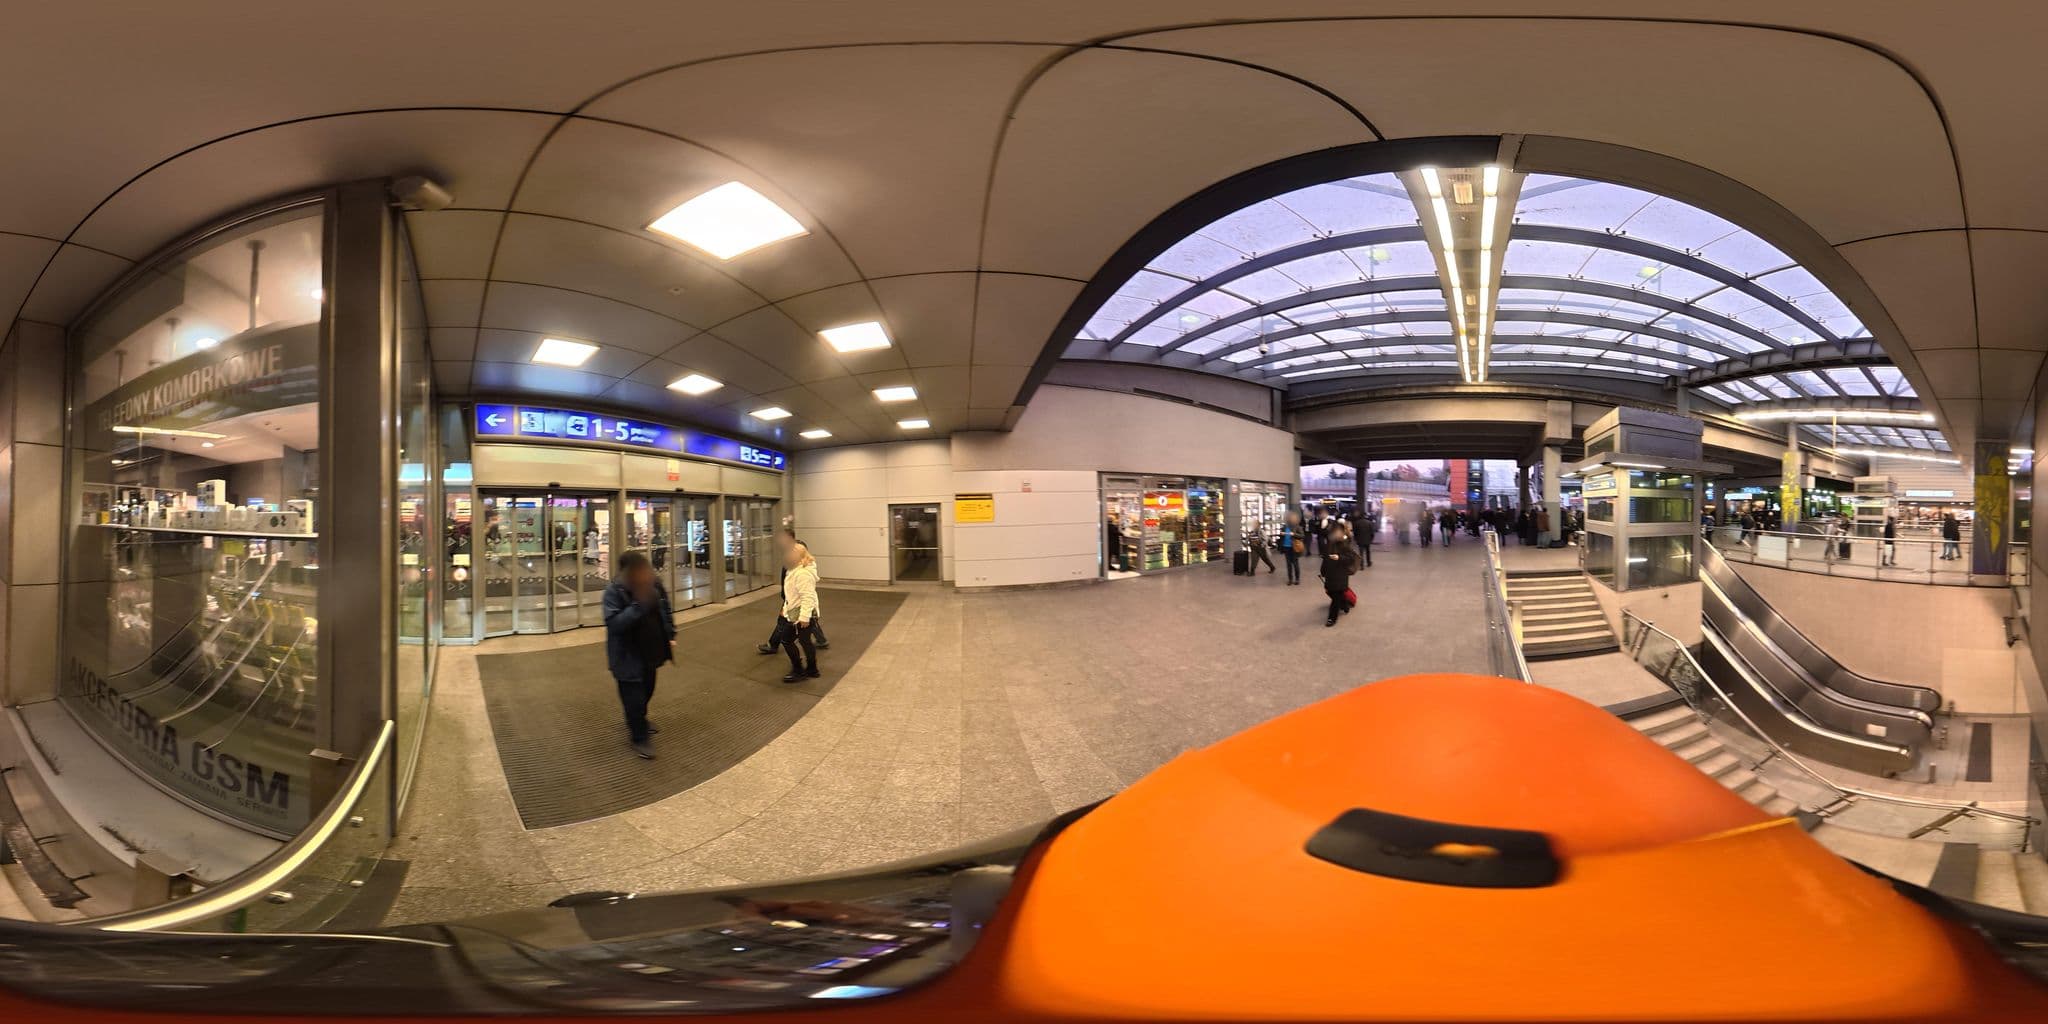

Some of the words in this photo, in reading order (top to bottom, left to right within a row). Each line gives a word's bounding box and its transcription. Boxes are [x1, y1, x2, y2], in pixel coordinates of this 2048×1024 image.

[592, 418, 629, 441] 1-5
[71, 656, 179, 766] AKCESORIA
[192, 741, 289, 809] GSM
